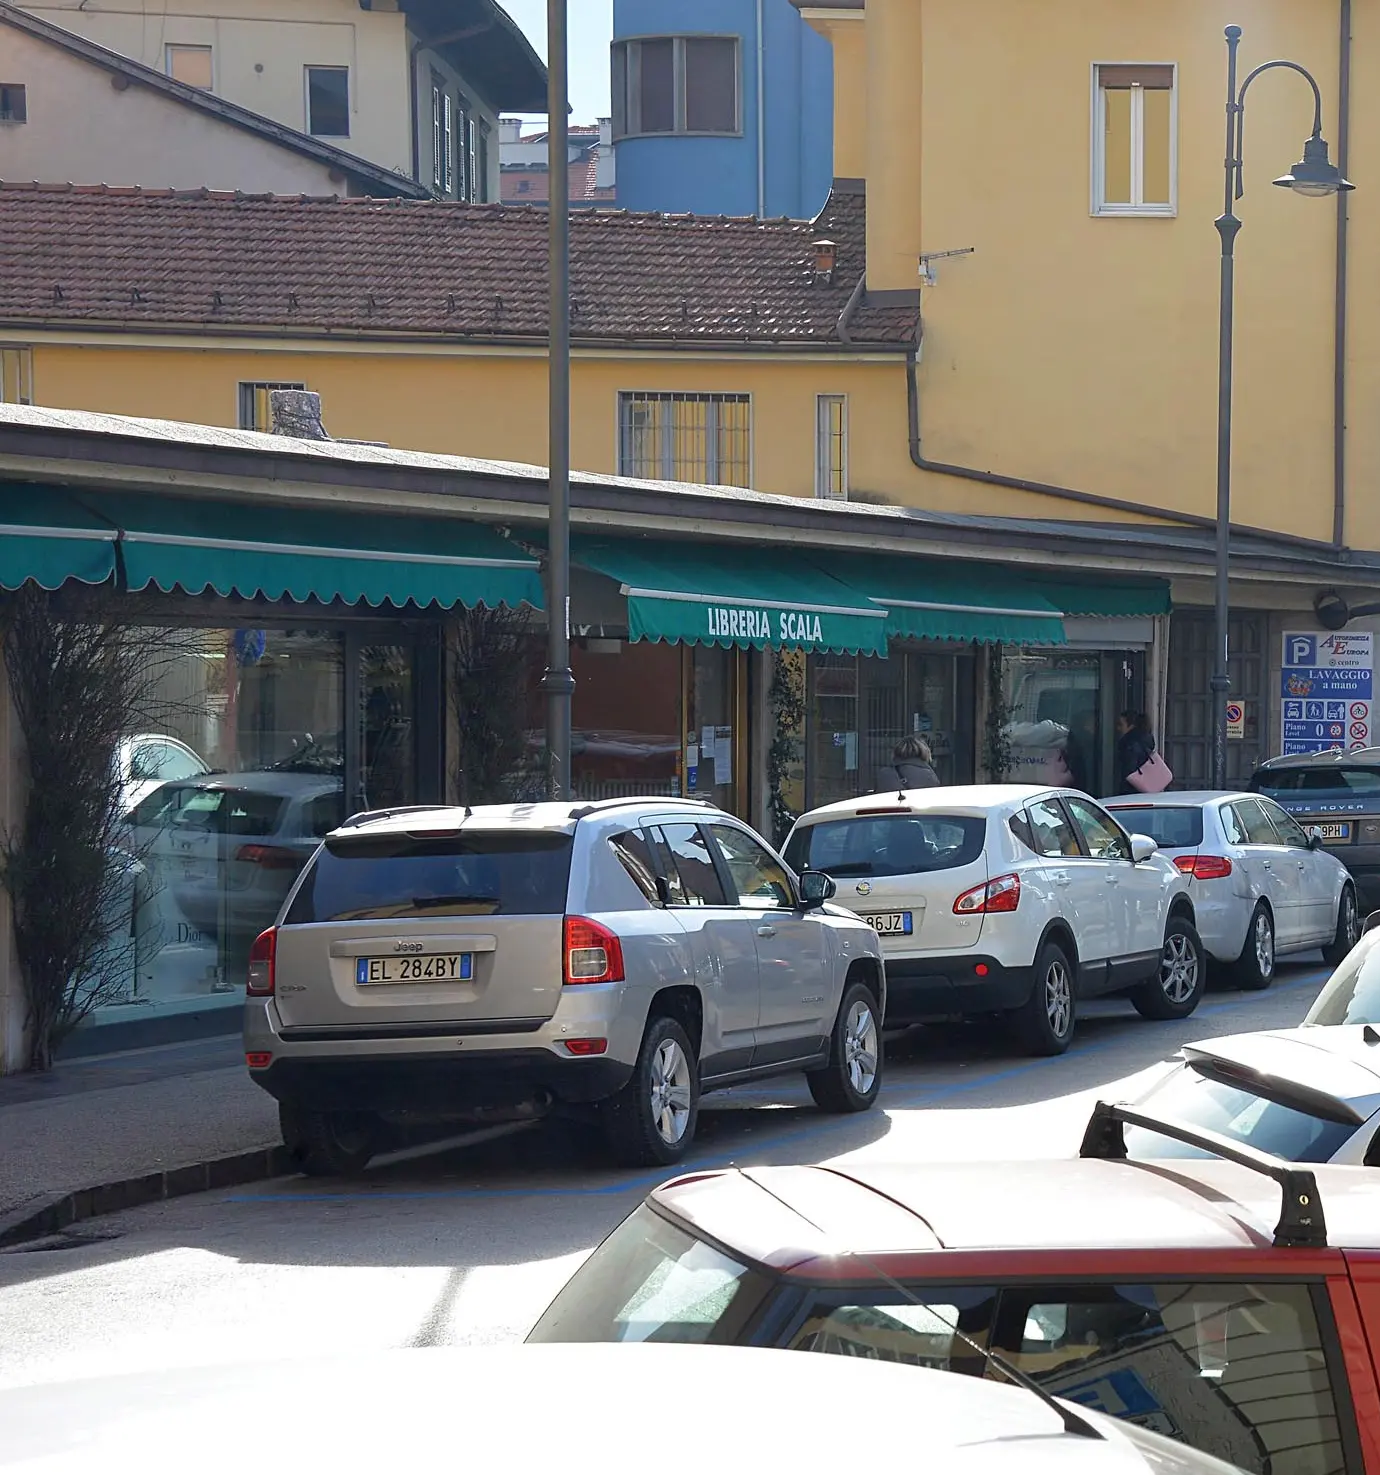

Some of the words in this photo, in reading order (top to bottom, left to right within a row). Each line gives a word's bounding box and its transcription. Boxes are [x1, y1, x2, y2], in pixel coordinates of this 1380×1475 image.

[708, 608, 771, 638] LIBRERIA
[780, 612, 824, 642] SCALA
[1309, 669, 1370, 680] LAVAGGIO
[1331, 682, 1358, 690] mano
[1285, 723, 1306, 731] Piano
[1315, 723, 1324, 737] 0
[1285, 742, 1306, 750] Piano
[1320, 804, 1364, 812] ROVER
[177, 922, 202, 943] Dior
[393, 941, 424, 953] Jeep
[370, 960, 392, 981] EL
[400, 956, 458, 979] 284BY
